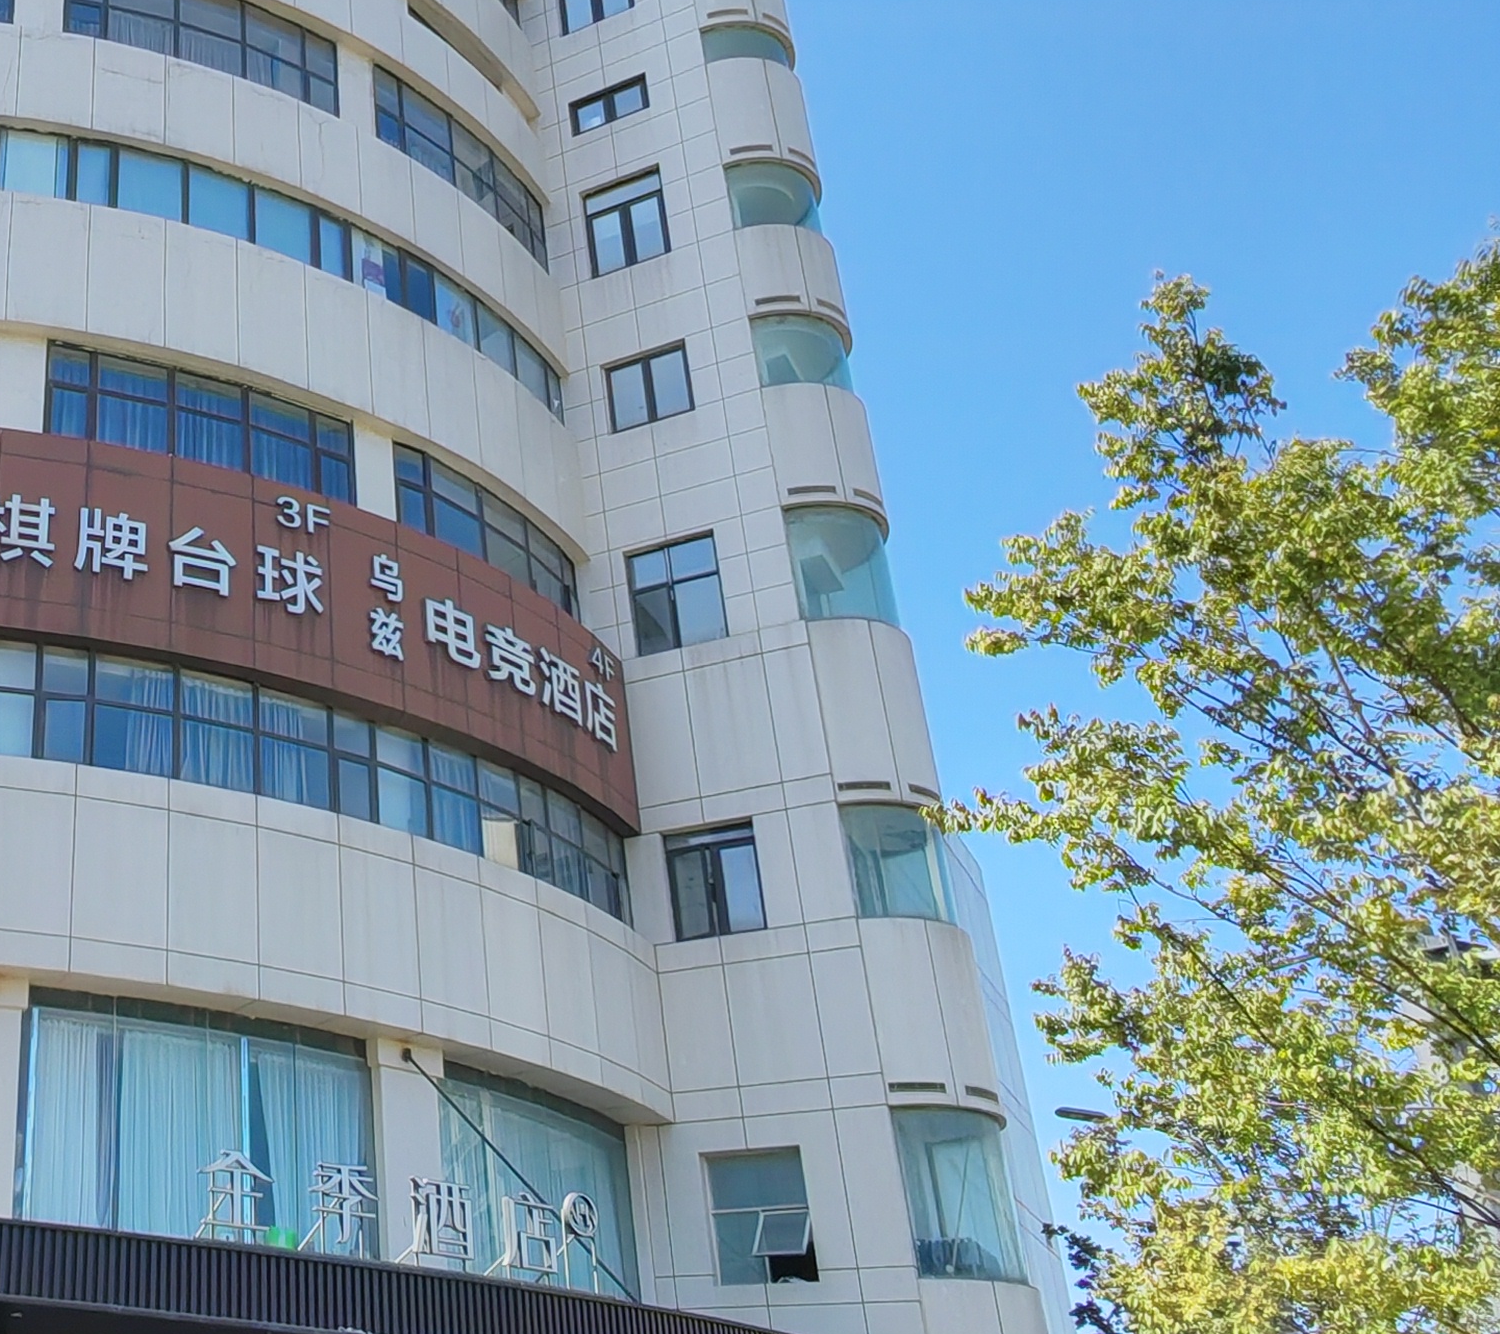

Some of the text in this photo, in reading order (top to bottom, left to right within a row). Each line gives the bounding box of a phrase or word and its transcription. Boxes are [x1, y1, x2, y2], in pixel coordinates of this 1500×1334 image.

[275, 496, 331, 535] 3F
[369, 553, 405, 663] 乌兹
[423, 596, 619, 754] 电竞酒店
[591, 646, 616, 682] 4F
[197, 1148, 559, 1274] 全季酒店
